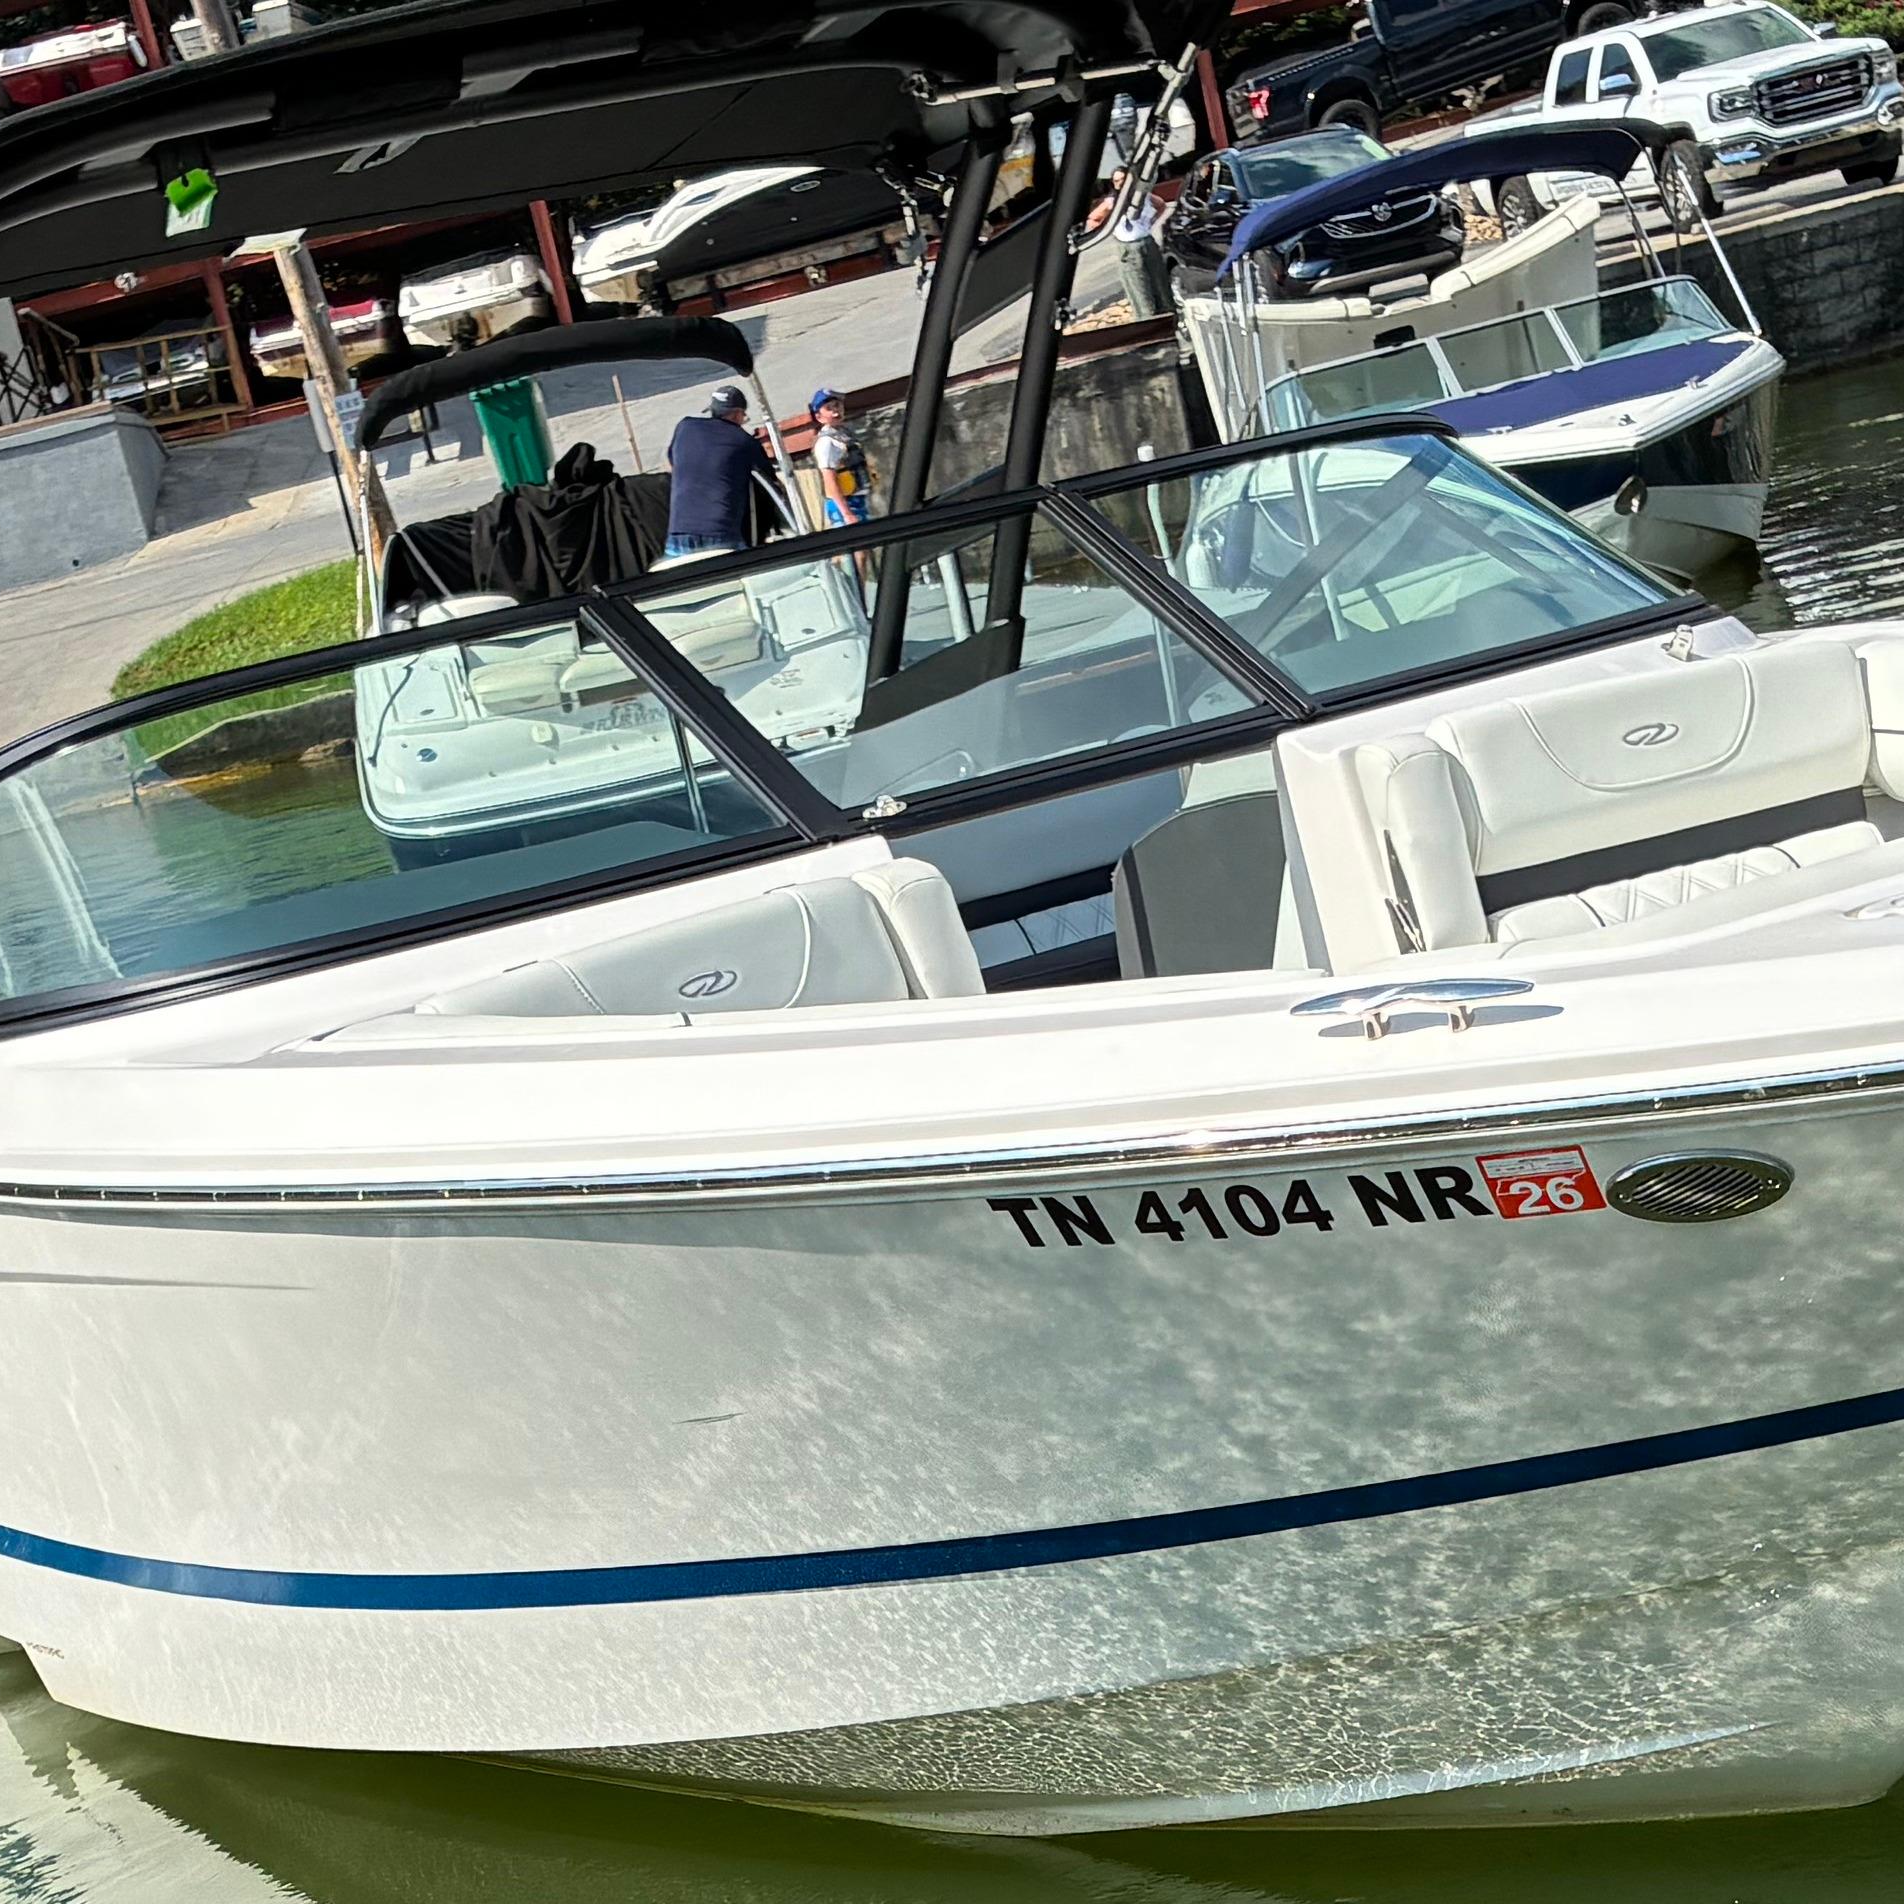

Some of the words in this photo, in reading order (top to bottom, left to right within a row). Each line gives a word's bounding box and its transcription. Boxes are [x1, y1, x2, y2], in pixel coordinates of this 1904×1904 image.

[985, 1195, 1116, 1248] TN
[1134, 1179, 1335, 1242] 4104
[1346, 1165, 1495, 1227] NR
[1508, 1176, 1584, 1215] 26
